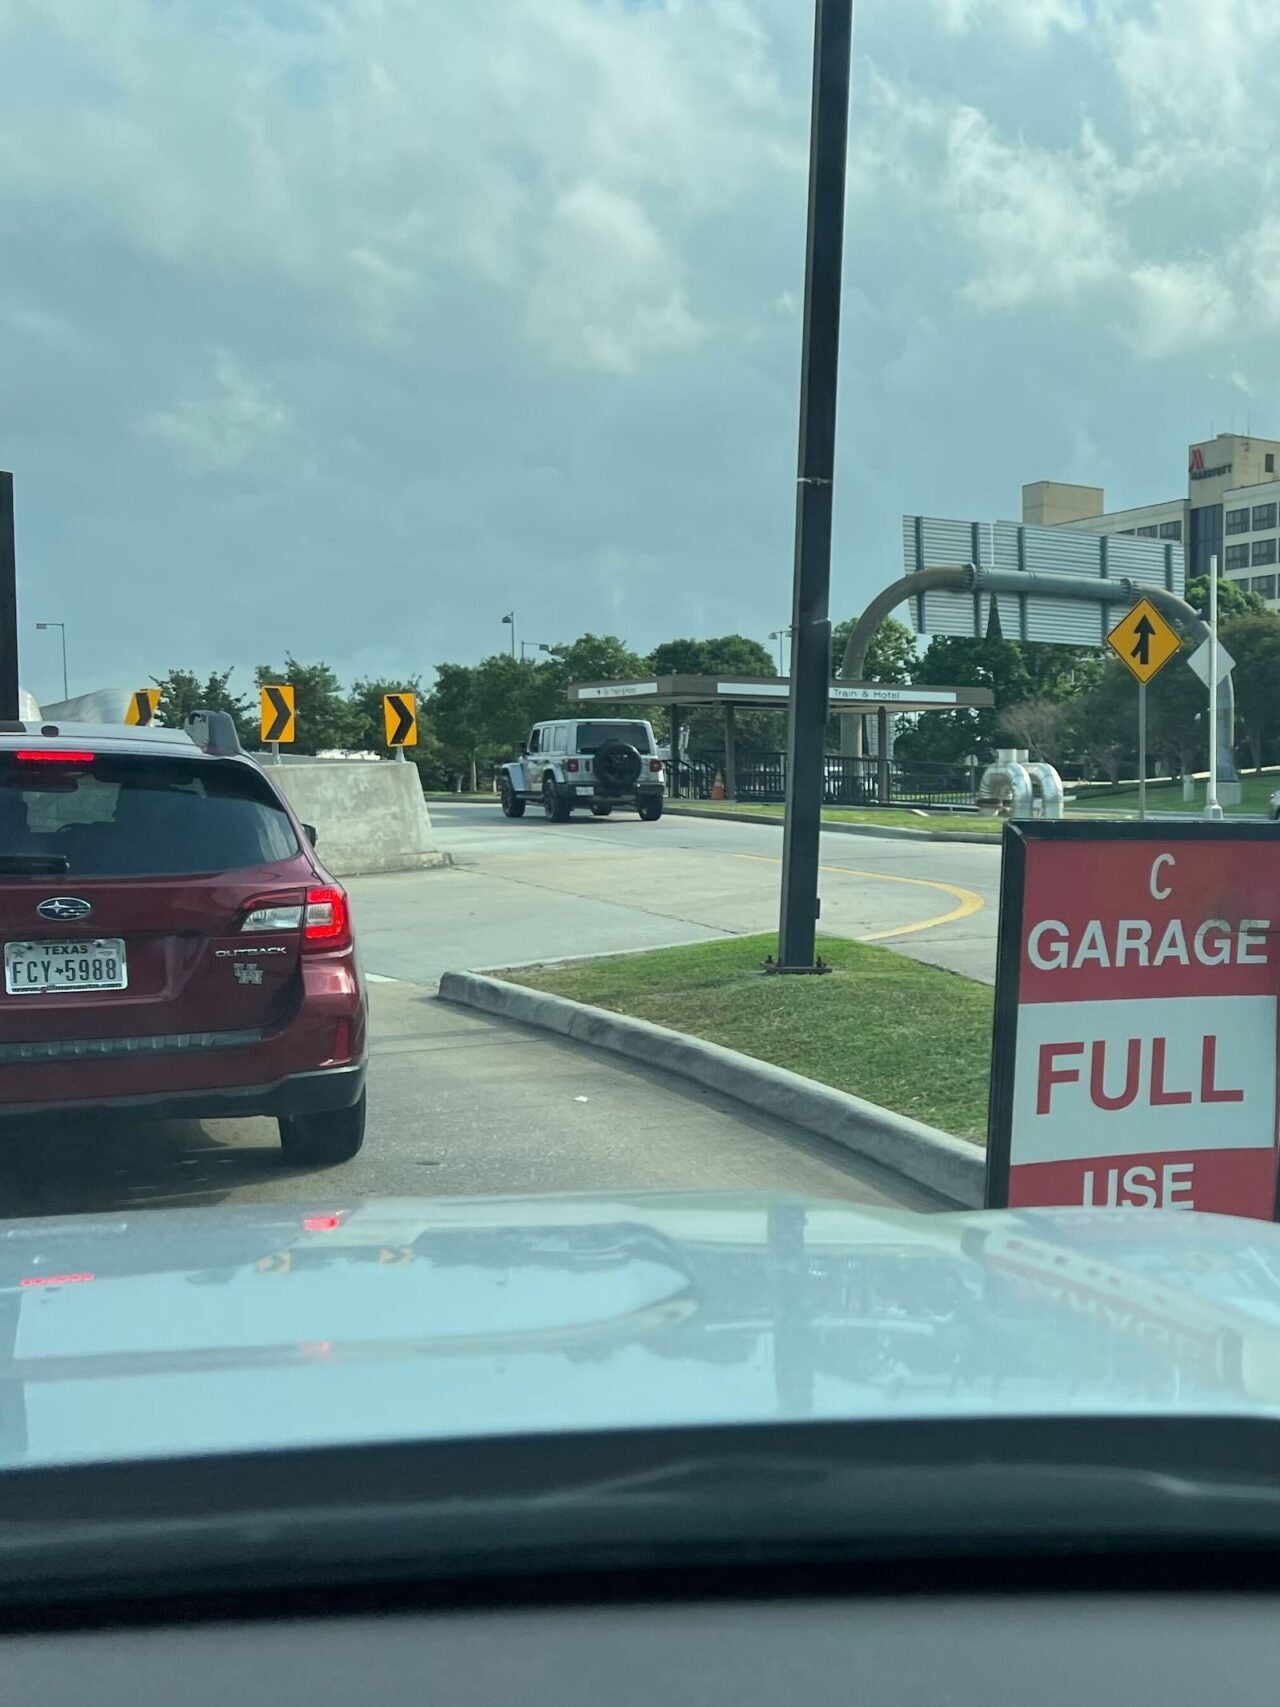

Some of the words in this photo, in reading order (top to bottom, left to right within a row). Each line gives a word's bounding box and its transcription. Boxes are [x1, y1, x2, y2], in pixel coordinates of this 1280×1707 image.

[833, 688, 857, 698] Train
[862, 689, 869, 698] &
[873, 691, 900, 699] Hotel
[1150, 853, 1176, 900] C
[42, 945, 89, 955] TEXAS
[215, 946, 288, 957] OUTBACK
[1027, 918, 1271, 970] GARAGE
[1036, 1035, 1244, 1115] FULL
[1082, 1163, 1195, 1211] USE
